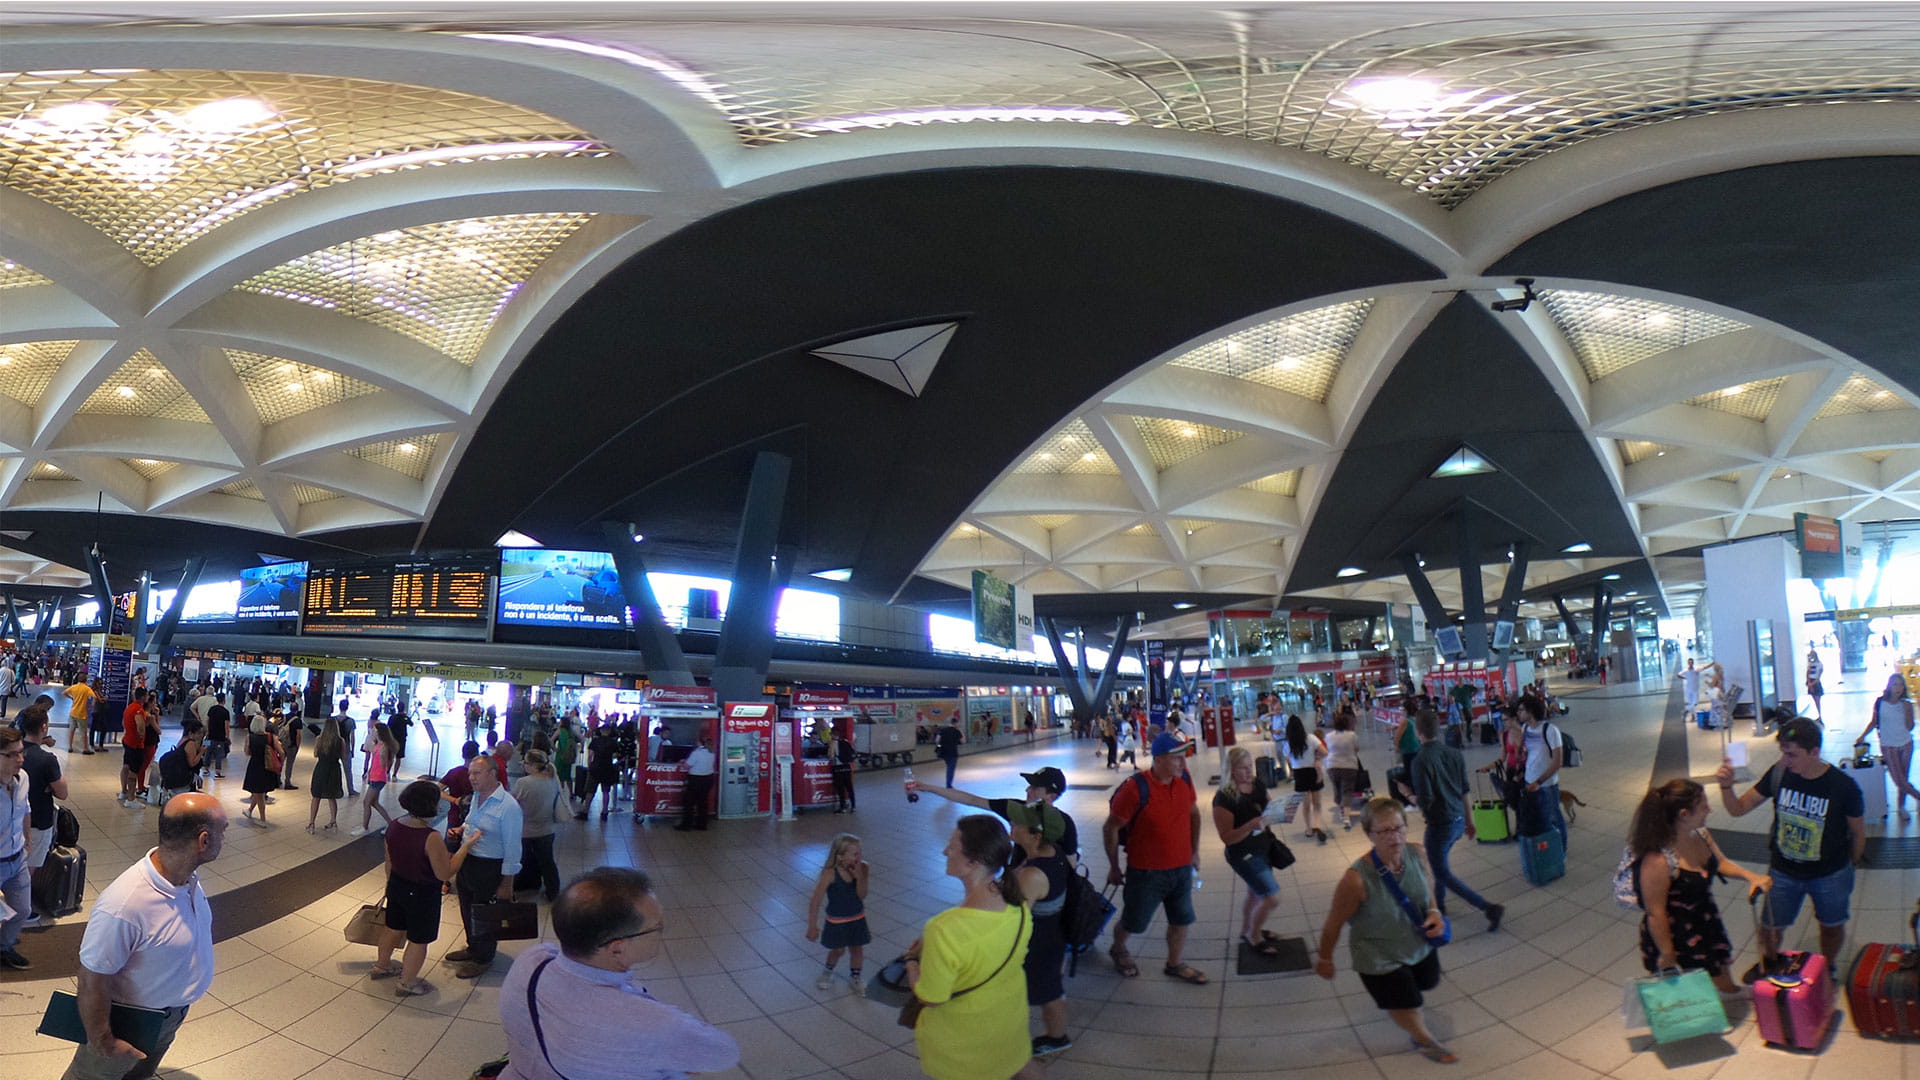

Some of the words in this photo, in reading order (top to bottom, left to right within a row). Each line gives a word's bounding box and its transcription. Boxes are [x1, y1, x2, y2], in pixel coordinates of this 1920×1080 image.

[504, 601, 545, 611] Rispondere
[546, 603, 554, 611] al
[555, 603, 585, 613] telefono
[504, 611, 518, 619] non
[537, 611, 572, 622] incidente,
[580, 614, 594, 622] una
[595, 614, 620, 624] scelta.
[1018, 613, 1032, 627] HDI
[306, 658, 327, 666] Binari
[354, 661, 374, 670] 2-14
[425, 664, 453, 676] Binari
[493, 670, 522, 680] 15-24
[1779, 787, 1830, 817] MALIBU
